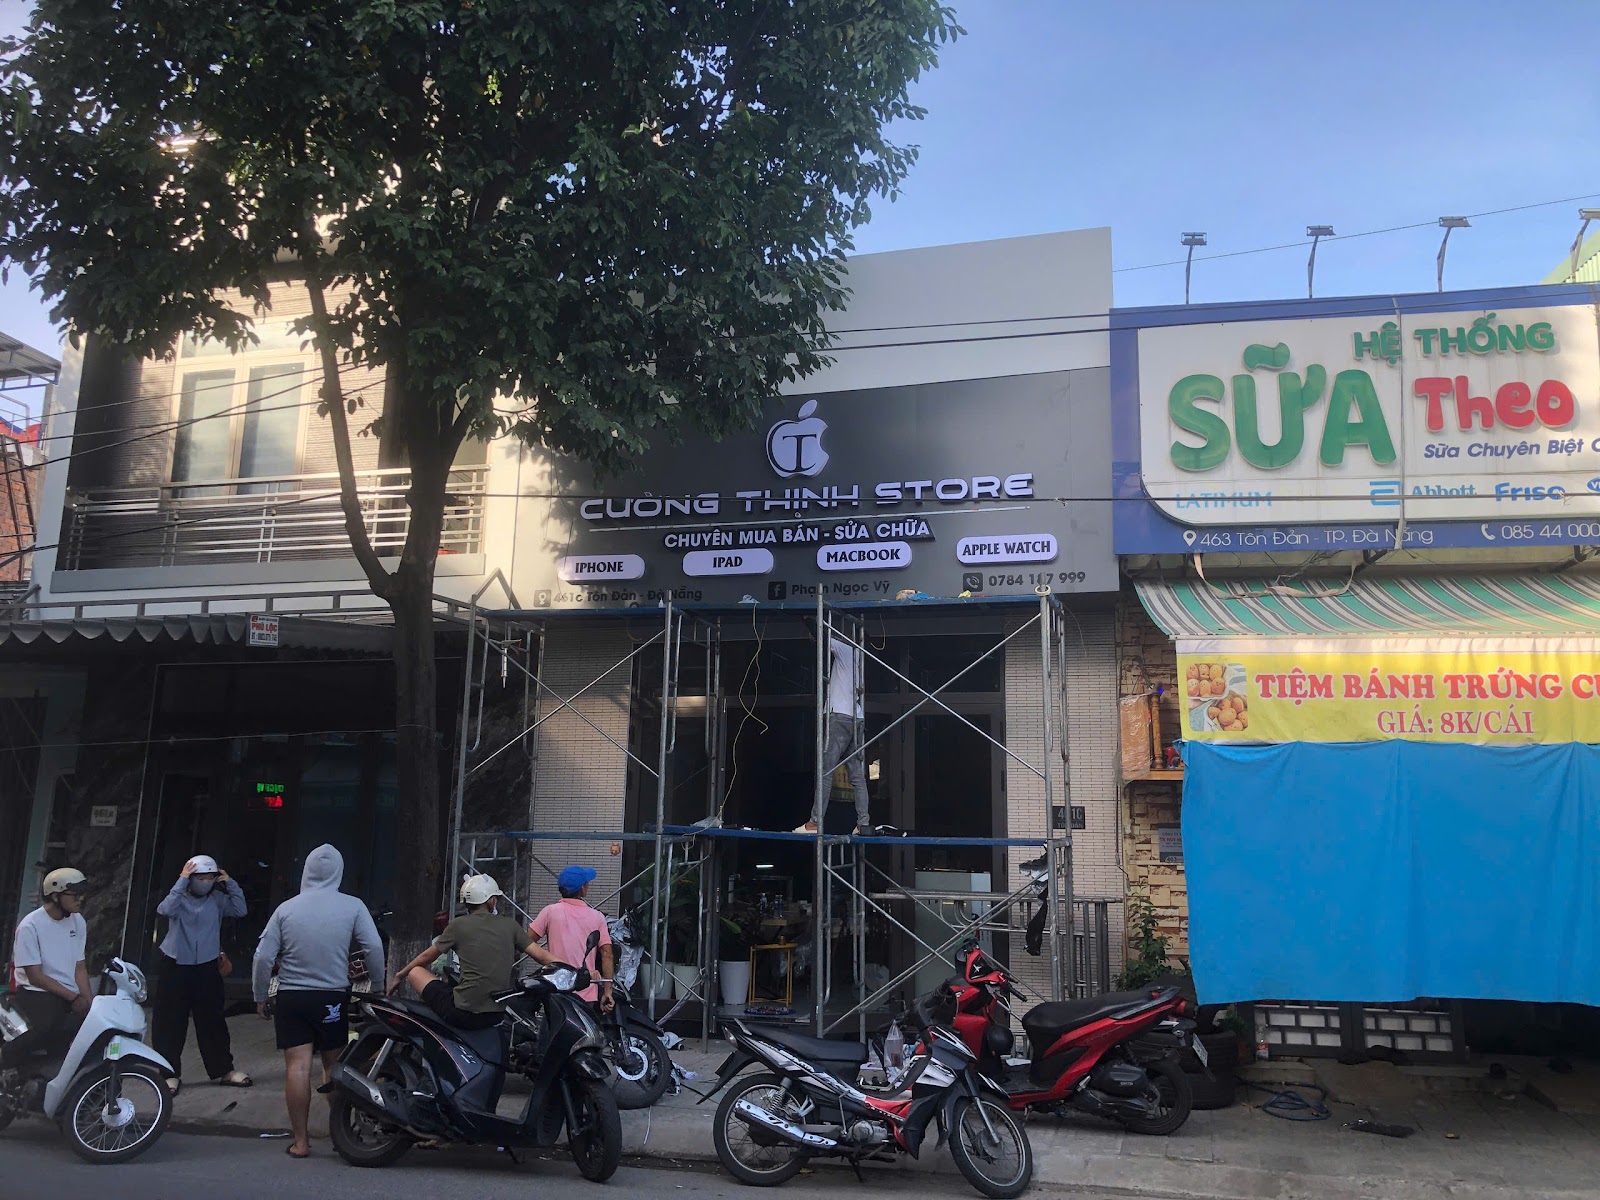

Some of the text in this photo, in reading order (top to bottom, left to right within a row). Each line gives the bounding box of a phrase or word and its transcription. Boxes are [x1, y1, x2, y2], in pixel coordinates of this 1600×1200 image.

[1353, 312, 1556, 367] HỆ THỐNG
[1168, 342, 1397, 472] SỮA
[1413, 375, 1576, 433] Theo
[1424, 442, 1460, 459] Sữa
[1467, 441, 1541, 459] Chuyên
[1548, 438, 1585, 457] Biệt
[735, 484, 859, 518] THỊNH
[874, 473, 1034, 505] STORE
[1495, 482, 1566, 502] Friso
[664, 528, 733, 548] CHUYÊN
[739, 530, 777, 545] MUA
[782, 524, 819, 542] BÁN
[834, 520, 870, 540] SỬA
[876, 518, 931, 538] CHỮA
[1200, 532, 1232, 547] 463
[1237, 532, 1267, 546] Tôn
[1272, 529, 1309, 546] Đản
[1324, 529, 1348, 544] TP.
[1352, 528, 1379, 543] Đà
[1385, 526, 1434, 545] Nẵng
[1501, 522, 1600, 540] 085 44 000
[826, 548, 901, 563] MACBOOK
[962, 540, 1051, 556] APPLE WATCH
[575, 560, 624, 574] IPHONE
[712, 555, 743, 568] IPAD
[791, 580, 890, 598] Phạm Ngọc Vỹ
[988, 573, 1024, 587] 0784
[1059, 571, 1086, 584] 999
[587, 590, 608, 602] Tôn
[647, 588, 665, 600] Đà
[1255, 666, 1600, 706] TIỆM BÁNH TRỨNG C
[1377, 703, 1534, 734] GIÁ: 8K/CÁI
[1057, 807, 1083, 820] 41C
